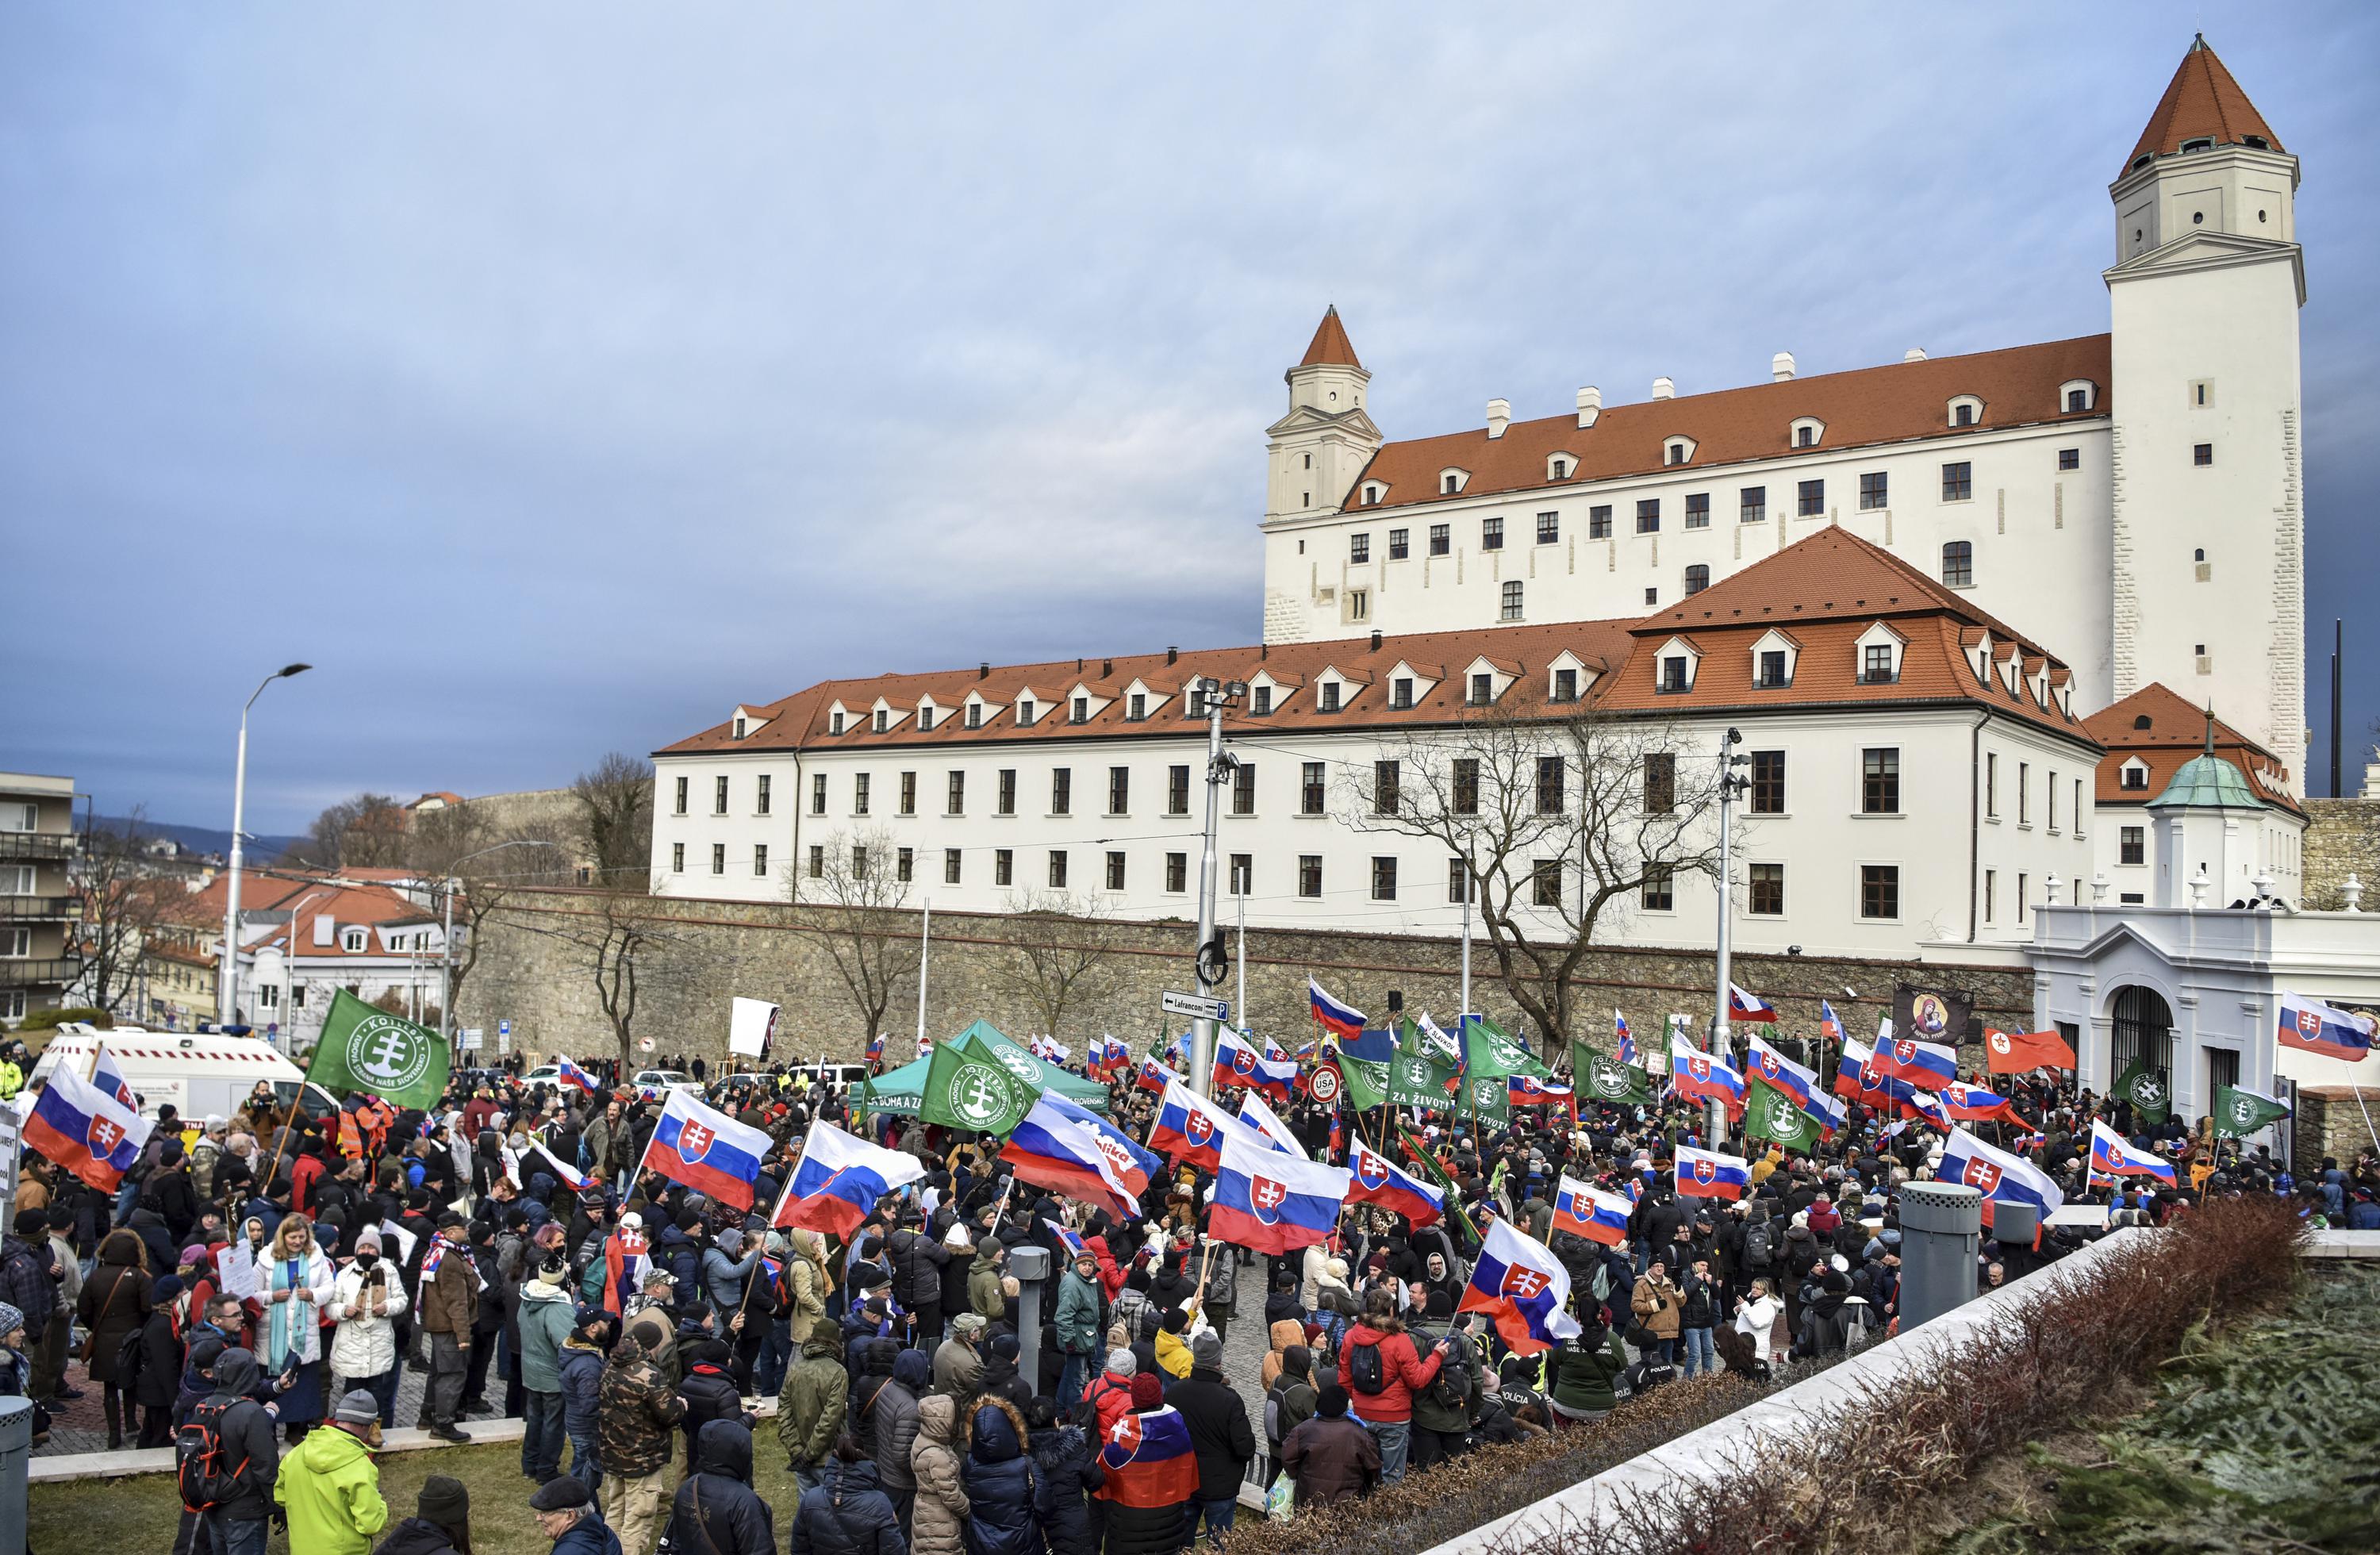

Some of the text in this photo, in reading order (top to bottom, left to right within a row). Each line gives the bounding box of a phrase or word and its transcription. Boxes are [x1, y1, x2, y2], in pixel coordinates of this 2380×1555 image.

[1174, 998, 1203, 1012] Lafranconi
[1220, 1004, 1225, 1016] P
[1431, 1031, 1455, 1050] SLAVKOV
[353, 1064, 374, 1083] STRANA
[376, 1078, 395, 1087] NAŠE
[397, 1053, 426, 1086] SLOVENSKO
[1315, 1078, 1334, 1088] USA
[878, 1095, 902, 1108] BOHA
[904, 1096, 911, 1108] A
[1073, 1096, 1105, 1105] SLOVENSKO
[1392, 1092, 1449, 1110] ZA ŽIVOT!
[970, 1117, 986, 1126] NAŠE
[986, 1094, 1007, 1123] SLOVENSKO
[1461, 1108, 1508, 1130] ZA ŽIVOT!
[2219, 1128, 2232, 1138] ZA
[1650, 1365, 1672, 1373] POLÍCIA
[1614, 1388, 1632, 1400] POLÍCI
